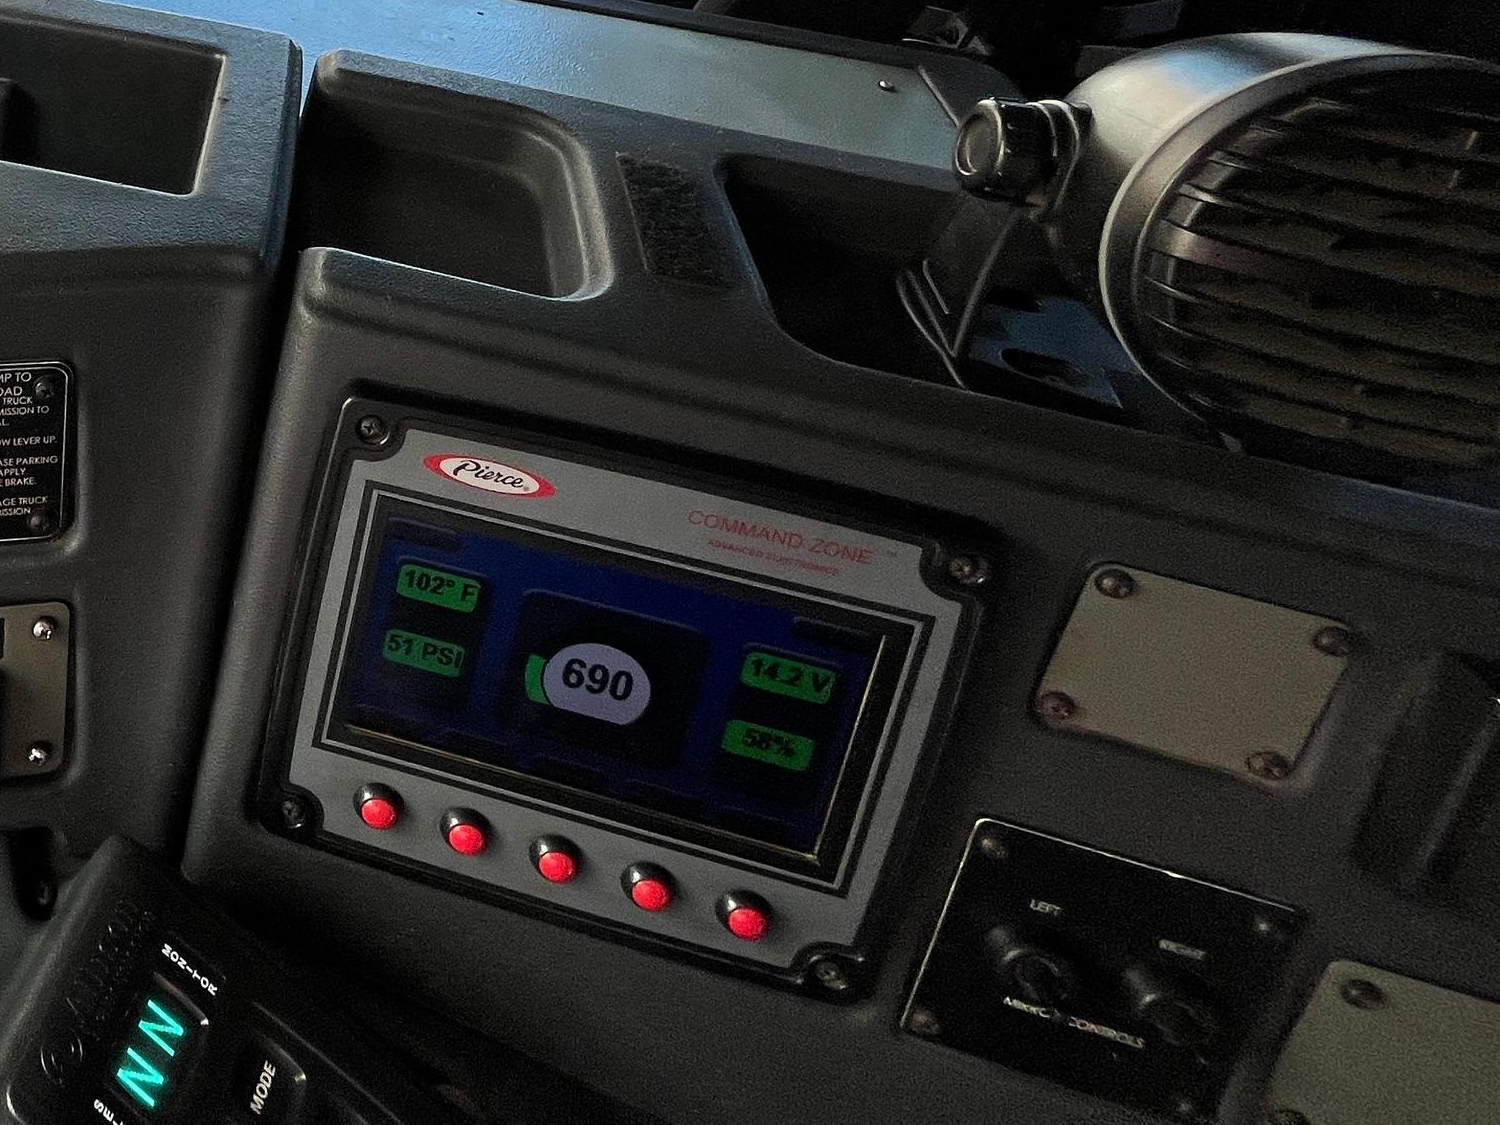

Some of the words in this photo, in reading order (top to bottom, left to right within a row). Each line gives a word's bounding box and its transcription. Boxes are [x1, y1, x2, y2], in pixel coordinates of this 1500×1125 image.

[15, 372, 32, 382] TO
[3, 396, 33, 405] TRUCK
[37, 405, 50, 414] TO
[13, 436, 40, 446] LEVER
[43, 435, 58, 444] UP.
[16, 455, 58, 465] PARKING
[453, 459, 524, 488] Pierce
[19, 496, 48, 505] TRUCK
[687, 510, 804, 549] COMMAND
[808, 537, 874, 565] ZONE
[387, 634, 414, 655] 51
[422, 642, 463, 669] PSI
[562, 658, 634, 701] 690
[161, 943, 218, 996] MONITOR
[250, 1060, 276, 1115] MODE
